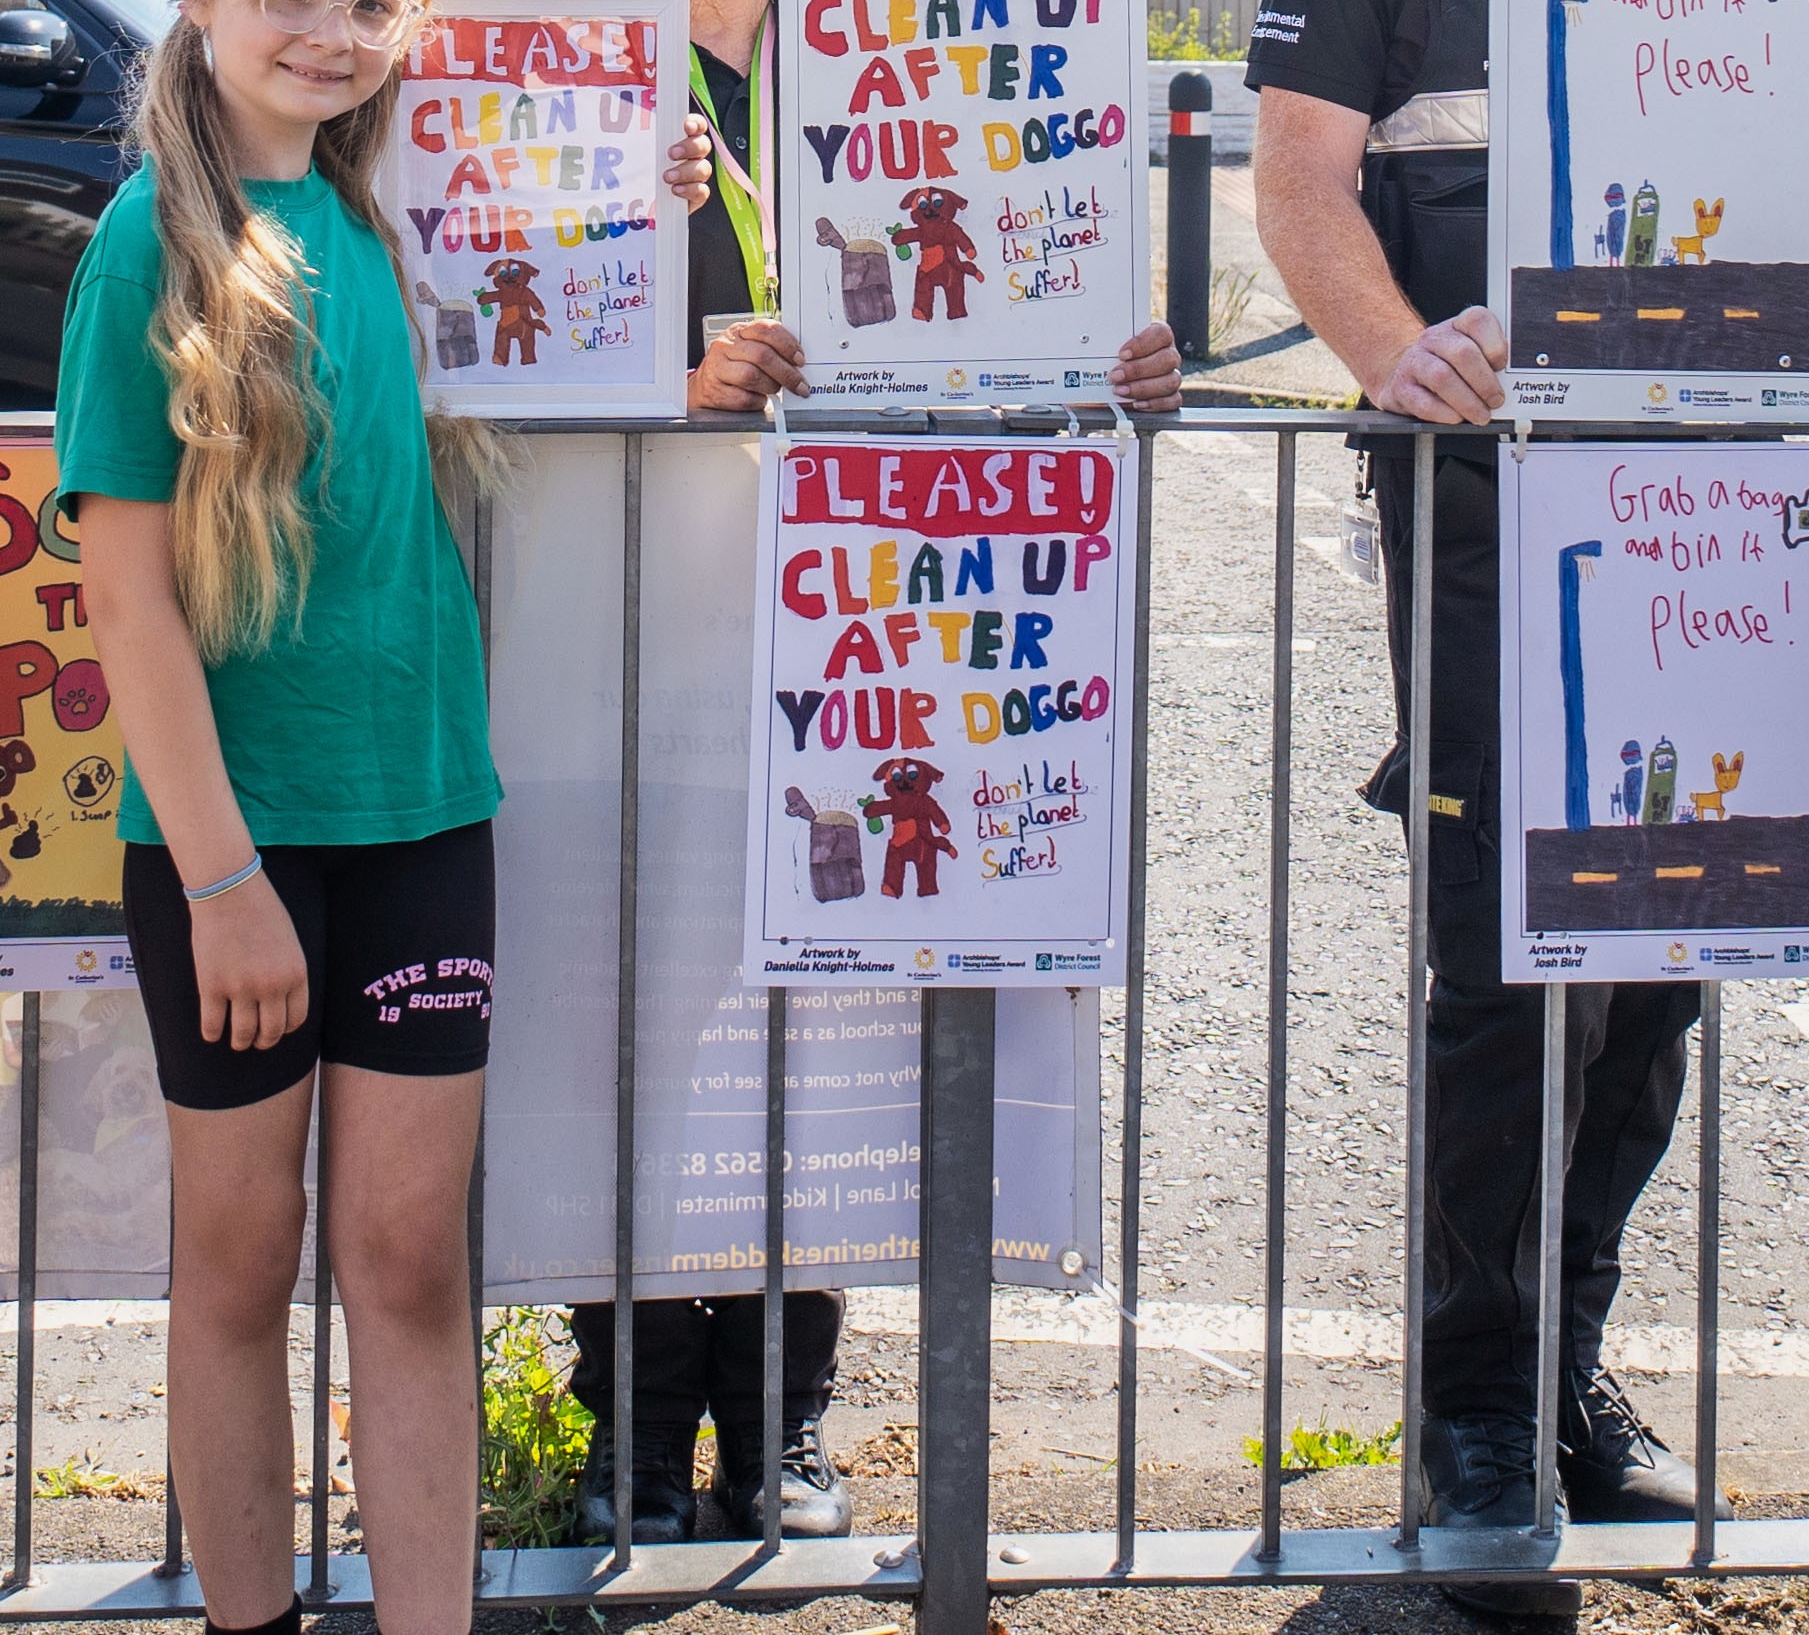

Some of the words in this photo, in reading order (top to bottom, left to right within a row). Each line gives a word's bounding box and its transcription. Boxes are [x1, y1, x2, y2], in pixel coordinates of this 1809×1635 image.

[848, 43, 1069, 117] AFTER
[410, 89, 576, 153] CLEAN
[802, 118, 960, 183] YOUR
[981, 103, 1126, 173] DOGGO
[444, 145, 624, 201] AFTER
[405, 205, 533, 255] YOUR
[996, 189, 1054, 233] don't
[1063, 185, 1102, 220] let
[1002, 234, 1038, 263] the
[1041, 220, 1102, 266] planet
[562, 262, 612, 296] don't
[617, 260, 650, 287] let
[566, 295, 595, 322] the
[598, 286, 649, 324] planet
[809, 383, 847, 395] aniella
[848, 381, 929, 396] Knight-Holmes
[835, 370, 880, 383] Artwork
[881, 370, 896, 383] by
[1512, 380, 1555, 393] Artwork
[1557, 381, 1570, 394] by
[1518, 393, 1542, 404] Josh
[1543, 393, 1565, 404] Bird
[784, 453, 1097, 524] PLEASE!
[1609, 464, 1695, 524] Grab
[1738, 478, 1787, 518] bag
[1624, 536, 1664, 560] and
[1671, 531, 1722, 572] bin
[1741, 530, 1765, 564] it
[782, 535, 995, 621] CLEAN
[1022, 534, 1112, 596] UP
[824, 610, 1054, 682] AFTER
[775, 686, 938, 752] YOUR
[960, 675, 1110, 745] DOGGO
[973, 763, 1033, 807] don't
[1043, 759, 1084, 796] let
[977, 808, 1011, 839] the
[1018, 797, 1082, 842] planet
[764, 961, 811, 973] Daniella
[812, 960, 895, 974] Knight-Holmes
[799, 947, 845, 959] Artwork
[846, 948, 861, 961] by
[1054, 953, 1076, 964] Wyre
[1077, 953, 1101, 963] Forest
[1528, 944, 1573, 956] Artwork
[1574, 944, 1589, 957] by
[1533, 957, 1559, 968] Josh
[1560, 957, 1583, 968] Bird
[363, 962, 428, 1001] THE
[408, 989, 484, 1010] SOCIETY
[378, 1004, 401, 1024] 19
